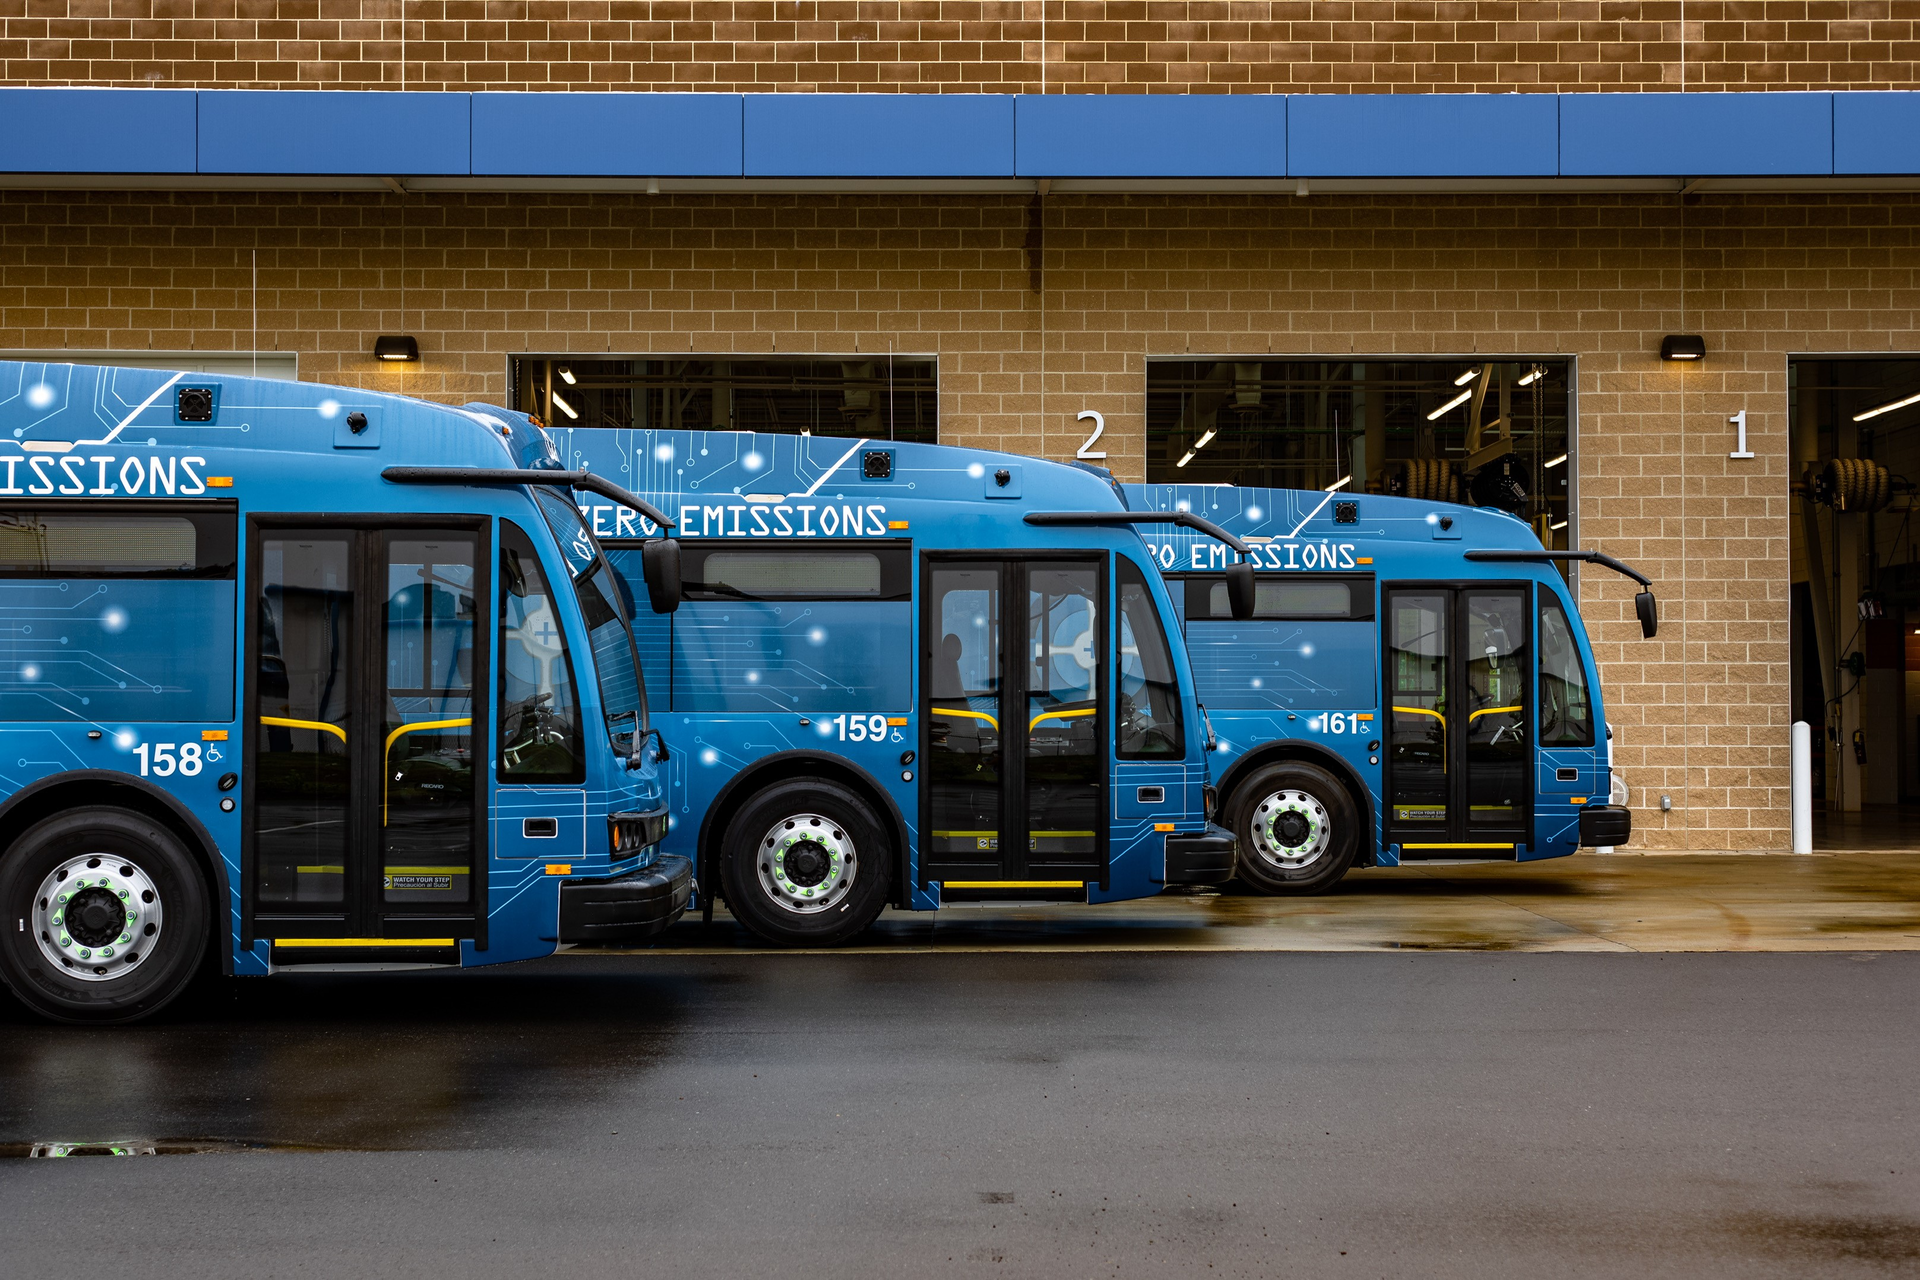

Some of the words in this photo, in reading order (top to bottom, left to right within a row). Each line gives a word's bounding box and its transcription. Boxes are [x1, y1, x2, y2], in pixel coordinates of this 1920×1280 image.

[1076, 410, 1107, 459] 2
[1729, 410, 1755, 458] 1
[0, 456, 207, 495] ISSIONS
[680, 505, 886, 536] EMISSIONS
[833, 714, 888, 742] 159
[1317, 712, 1358, 735] 161
[132, 742, 203, 777] 158
